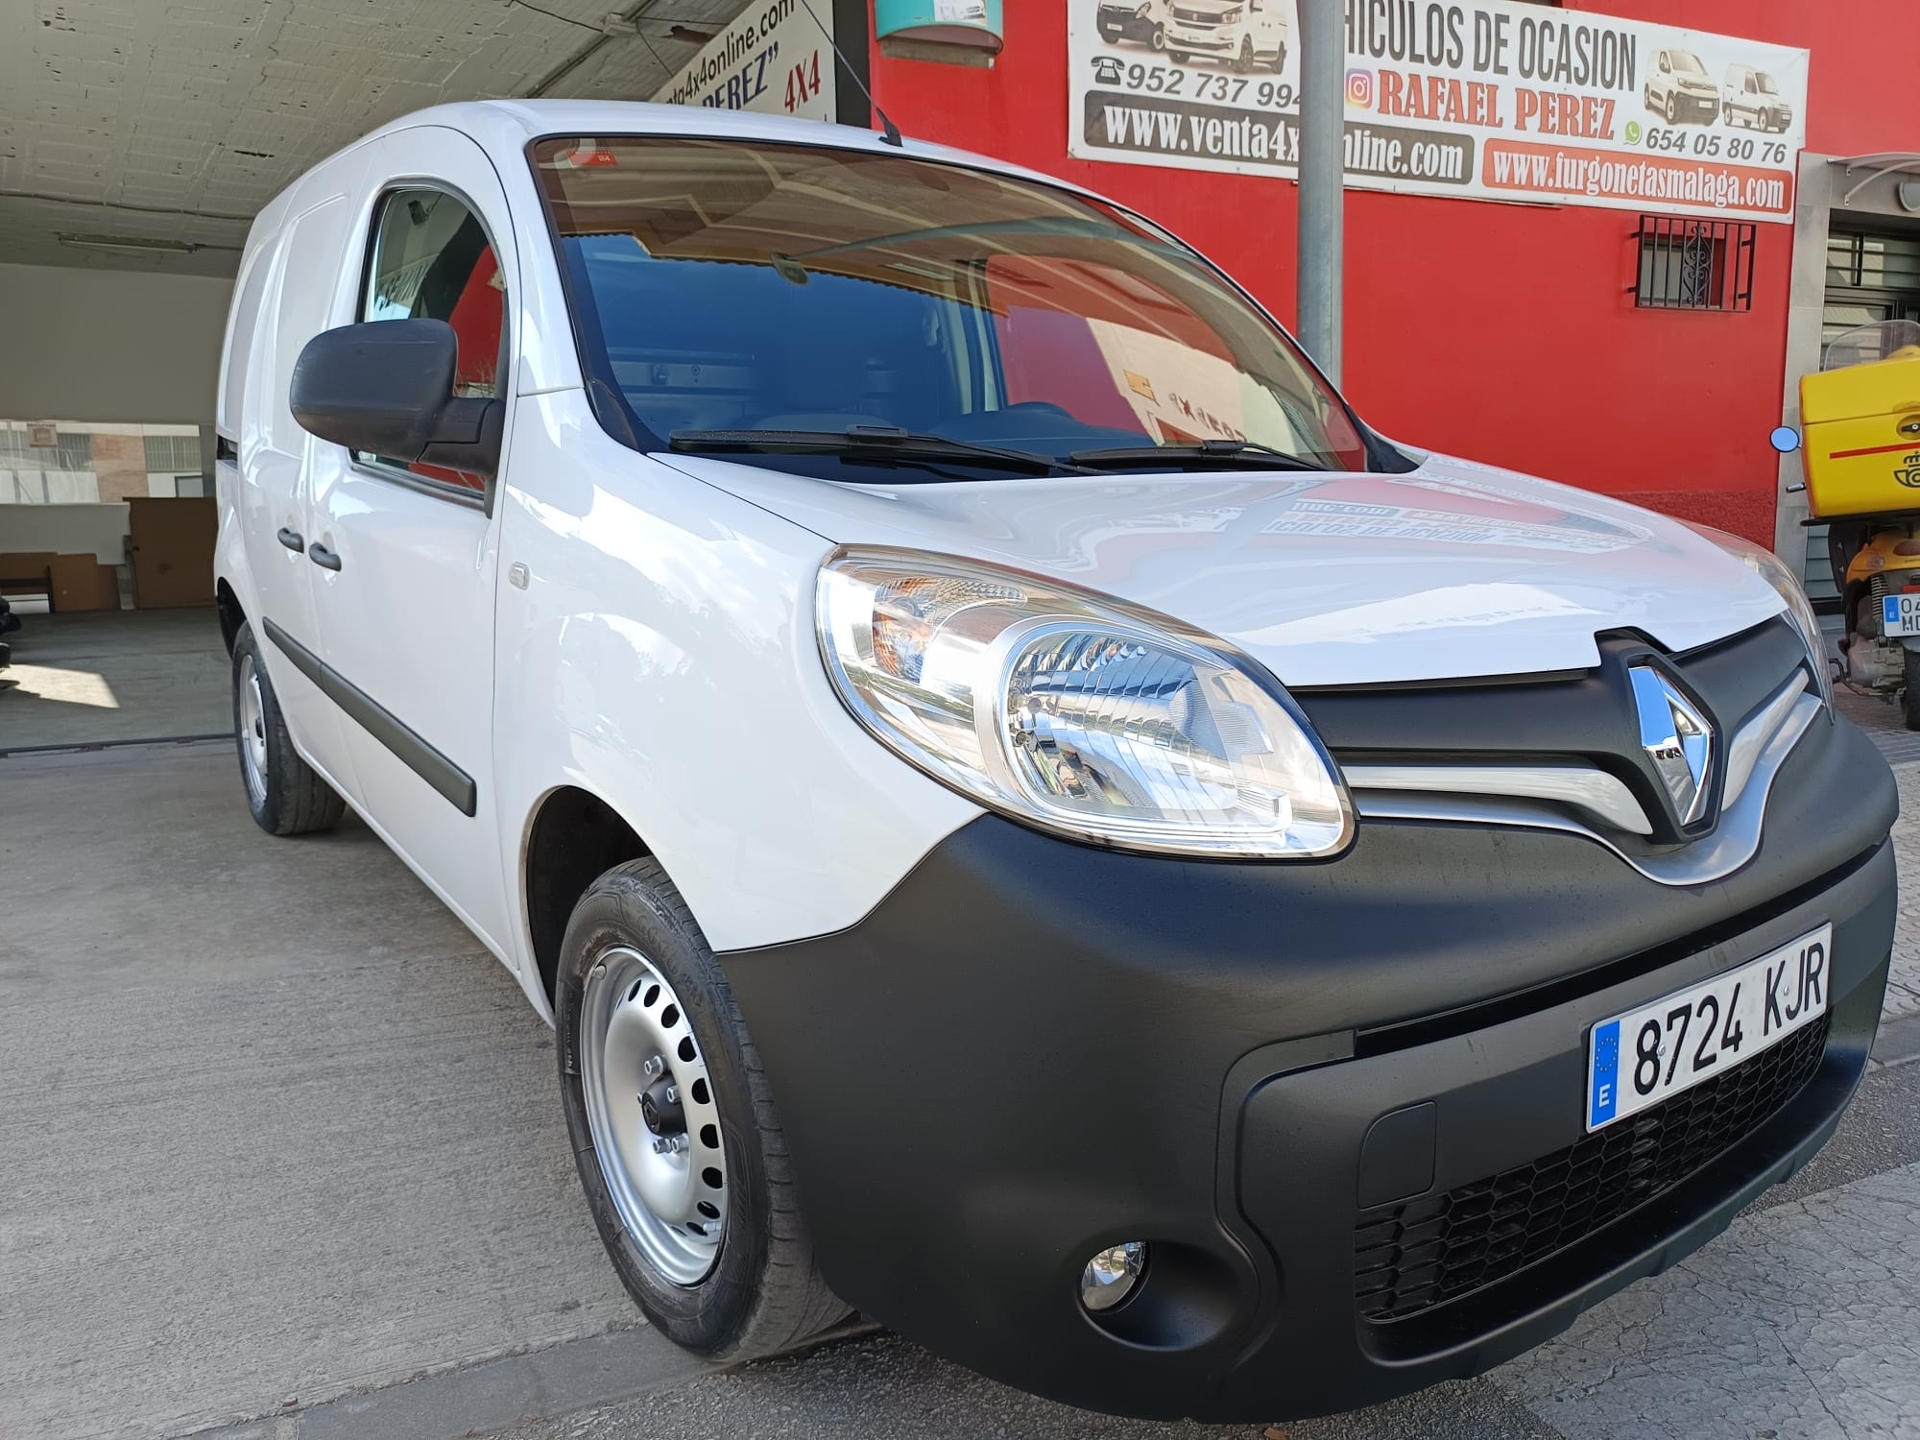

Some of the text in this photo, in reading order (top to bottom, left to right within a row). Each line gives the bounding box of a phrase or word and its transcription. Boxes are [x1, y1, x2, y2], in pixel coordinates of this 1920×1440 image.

[666, 0, 795, 105] ta4x4online.com
[1344, 0, 1636, 92] HICULOS DE OCASION
[785, 49, 821, 113] 4X4
[1126, 62, 1185, 96] 952
[1196, 72, 1248, 104] 737
[1378, 69, 1616, 141] RAFAEL PEREZ
[1646, 127, 1787, 164] 654 05 80 76
[1493, 151, 1784, 210] www.furgonetasmalaga.com
[1598, 942, 1824, 1108] E 8724 KJR
